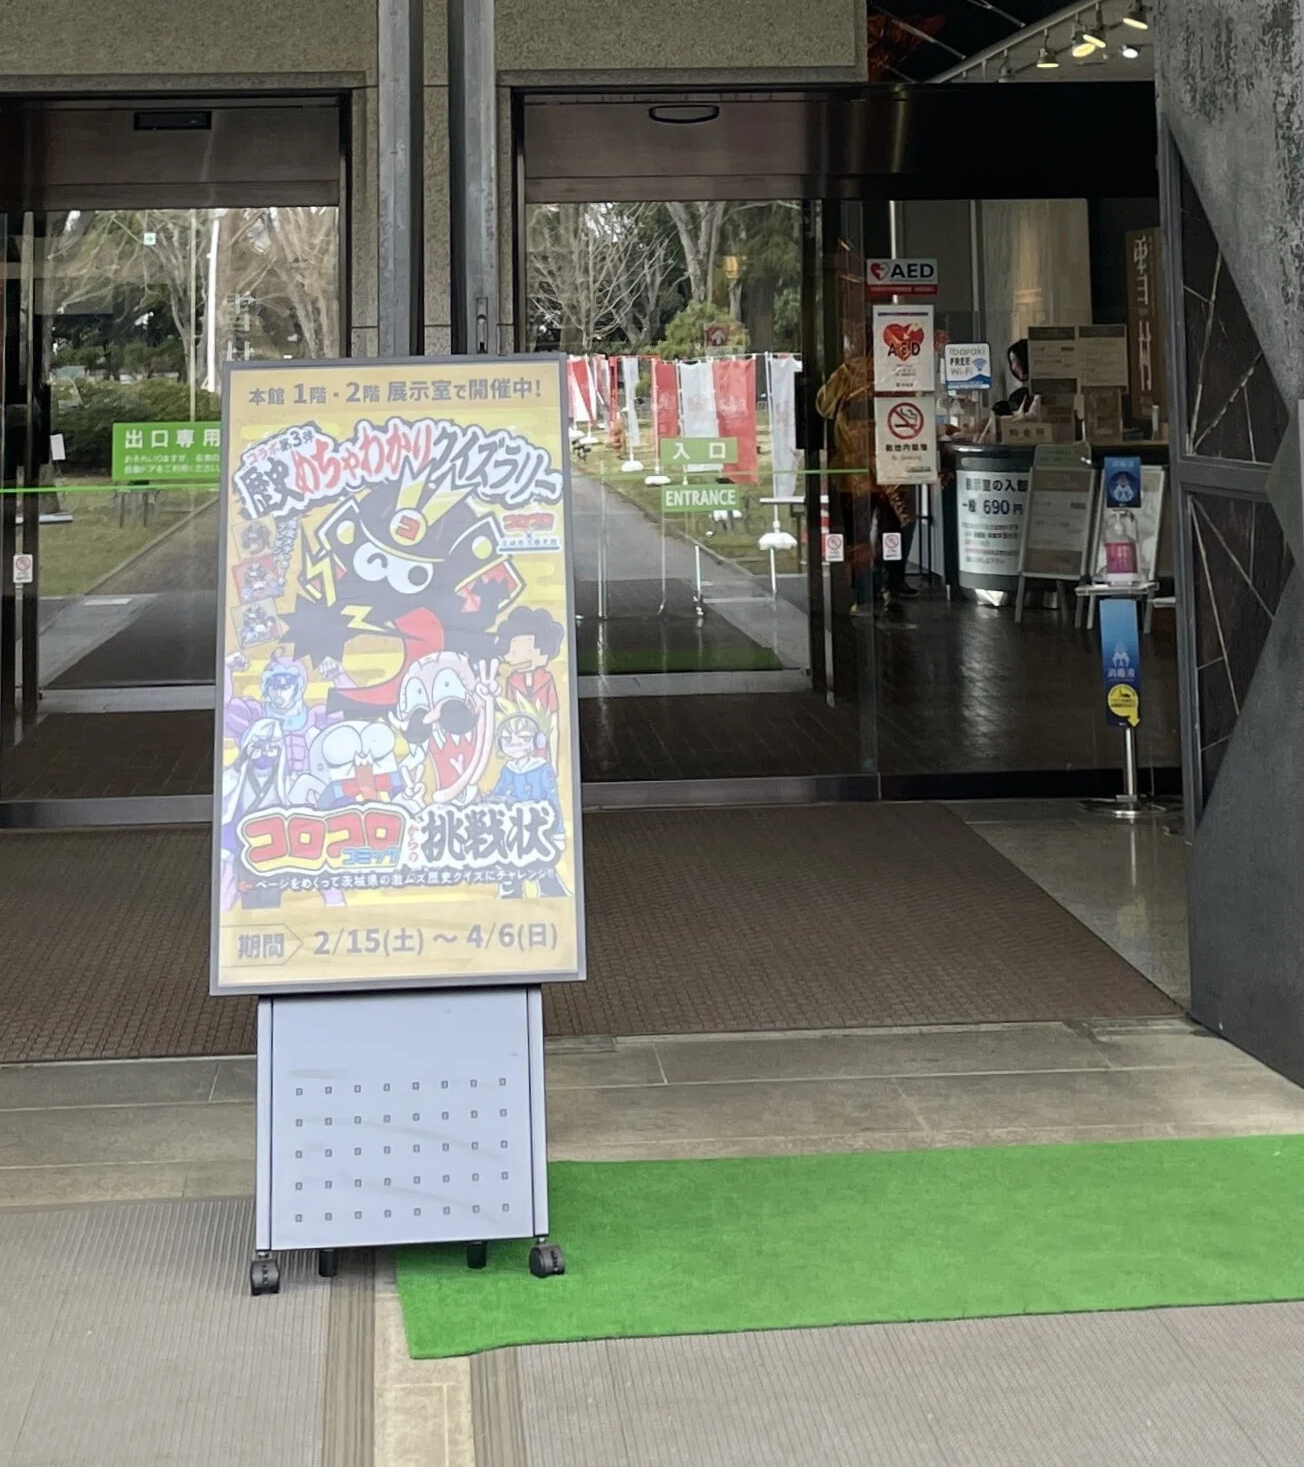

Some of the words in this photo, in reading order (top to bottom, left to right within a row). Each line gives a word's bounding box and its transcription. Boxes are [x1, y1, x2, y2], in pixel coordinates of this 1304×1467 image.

[890, 263, 935, 279] AED
[949, 357, 971, 366] FREE
[248, 388, 285, 406] 本館
[125, 429, 221, 449] 出口専用
[672, 442, 727, 460] 入口
[665, 489, 737, 507] ENTRANCE
[245, 810, 402, 863] コロコロ
[407, 823, 420, 863] からの
[421, 806, 553, 864] 挑戦状
[238, 934, 285, 959] 期間
[313, 928, 424, 957] 2/15(土)
[465, 923, 558, 951] 4/6(日)
